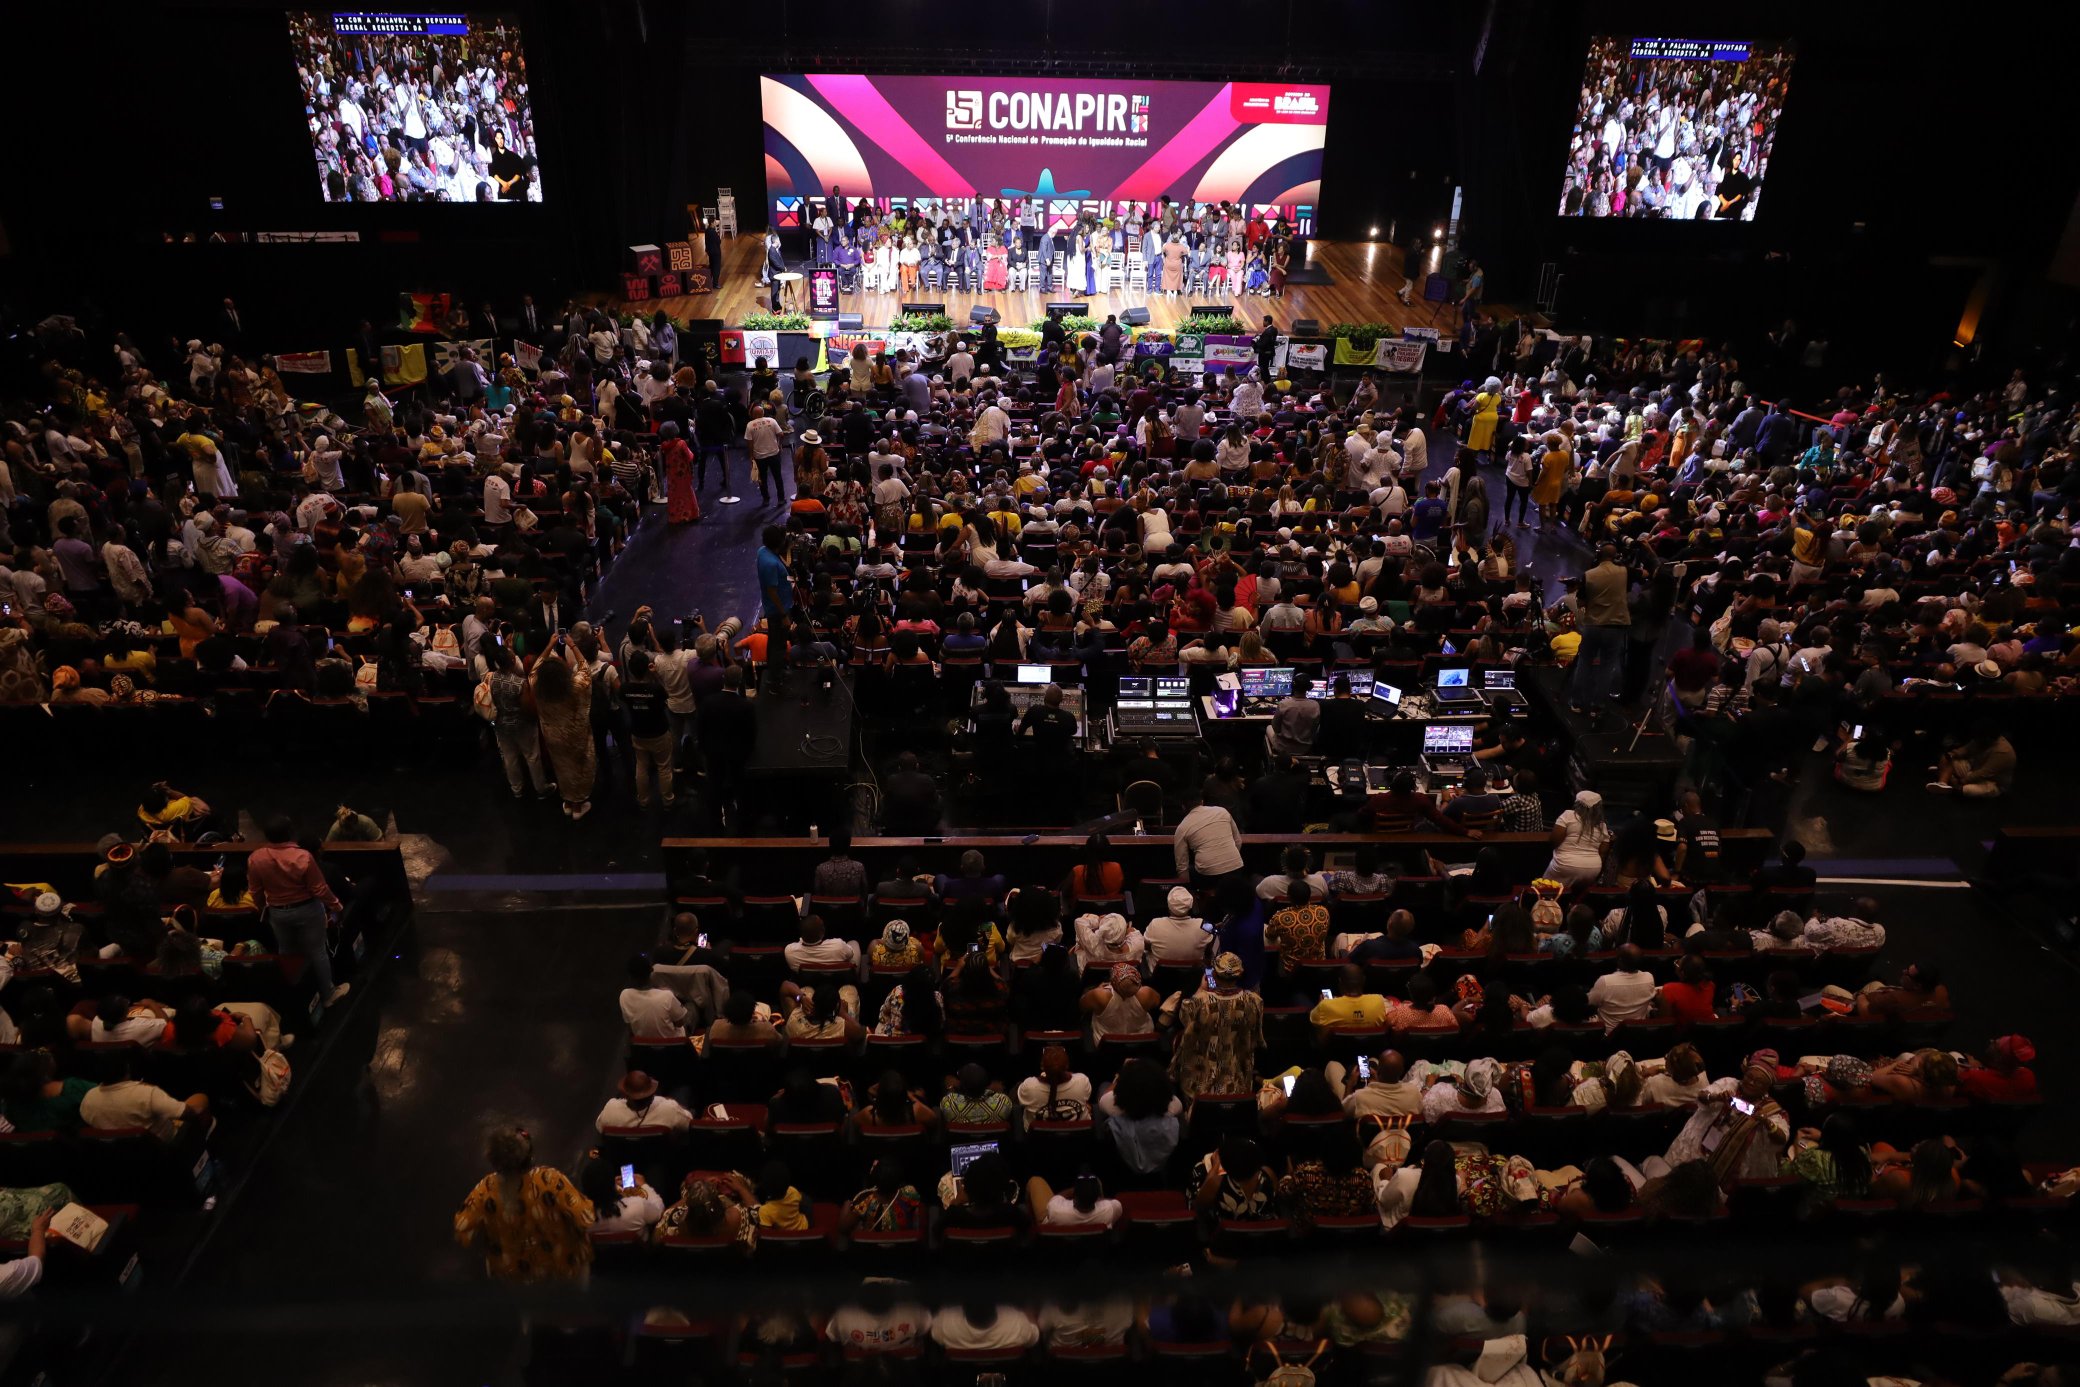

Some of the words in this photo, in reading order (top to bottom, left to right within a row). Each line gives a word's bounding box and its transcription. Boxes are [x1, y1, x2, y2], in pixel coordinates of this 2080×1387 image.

[989, 91, 1128, 131] CONAPIR
[955, 134, 996, 143] Conferência
[998, 135, 1028, 144] Nacional
[1030, 136, 1038, 144] de
[1041, 136, 1076, 146] Promoção
[1125, 138, 1147, 147] Racial
